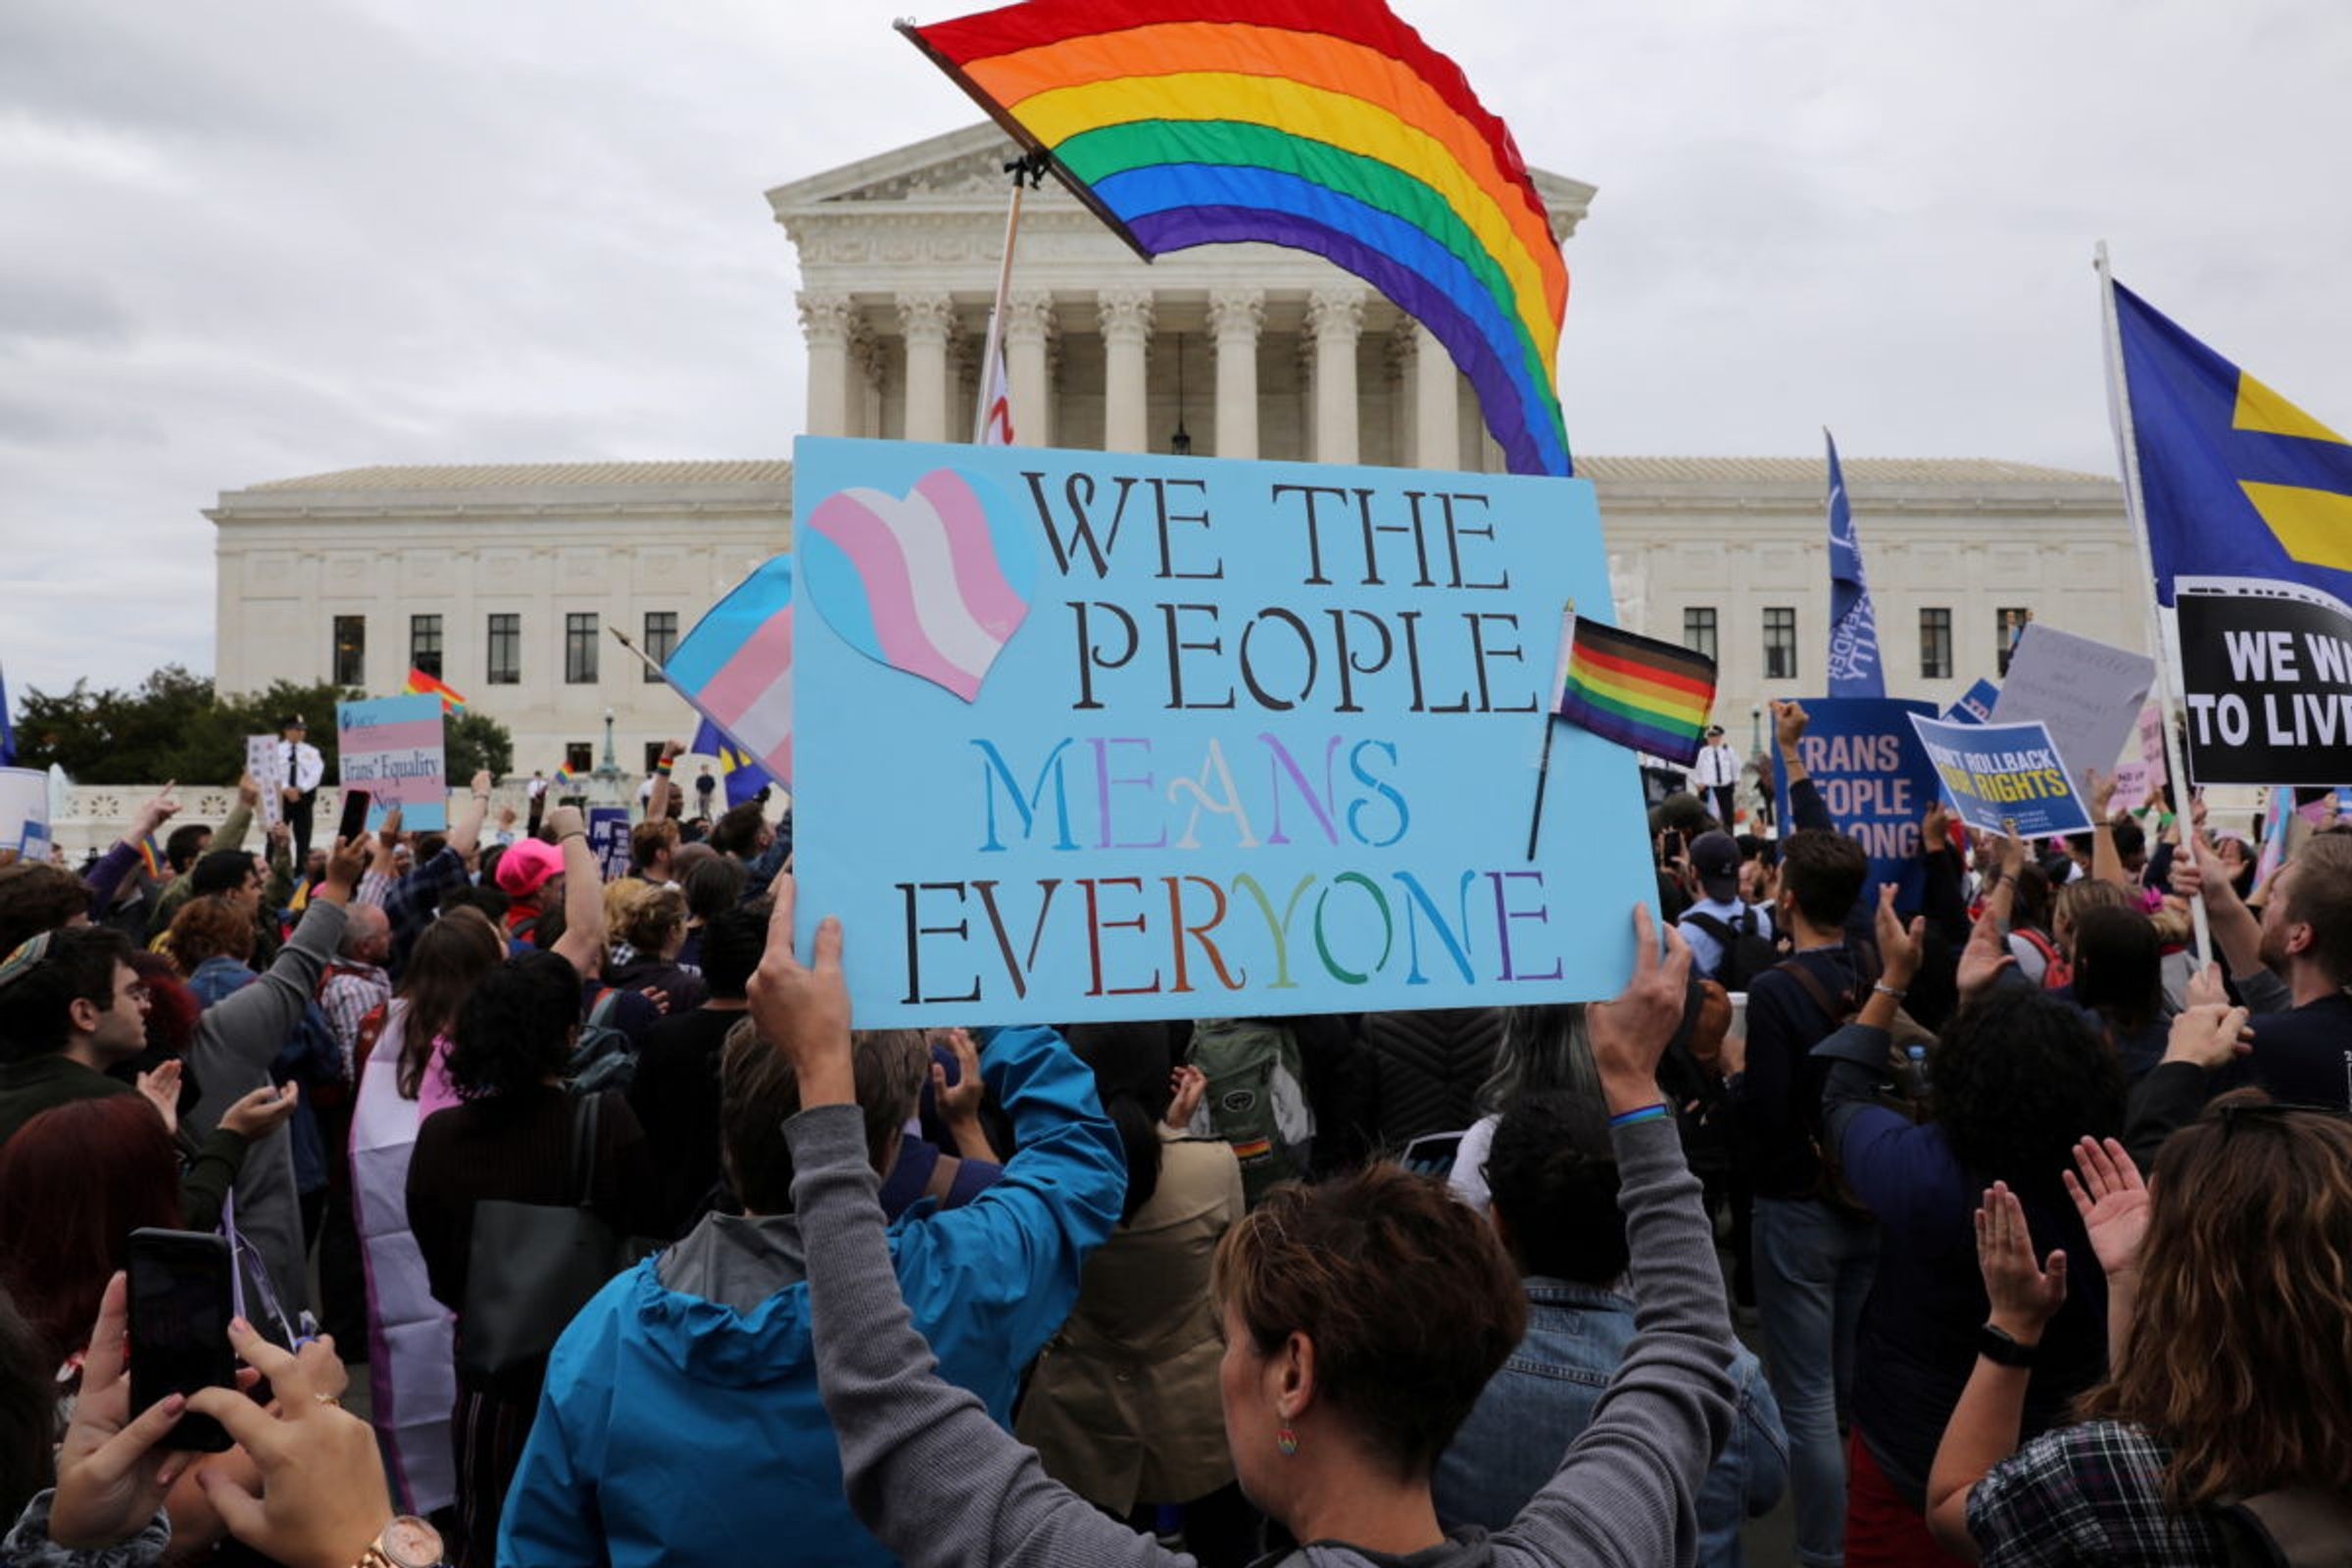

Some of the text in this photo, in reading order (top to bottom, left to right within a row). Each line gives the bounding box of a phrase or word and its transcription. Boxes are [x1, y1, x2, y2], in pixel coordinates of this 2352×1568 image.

[1019, 471, 1509, 589] WE THE
[1065, 601, 1538, 712] PEOPLE
[2224, 631, 2300, 681] WE
[2187, 694, 2249, 747] TO
[381, 751, 439, 787] Equality
[1964, 749, 2056, 774] ROLLBACK
[1973, 768, 2069, 803] RIGHTS
[968, 733, 1410, 850] MEANS
[1788, 779, 1913, 815] OPLE
[896, 871, 1563, 1004] EVERYONE
